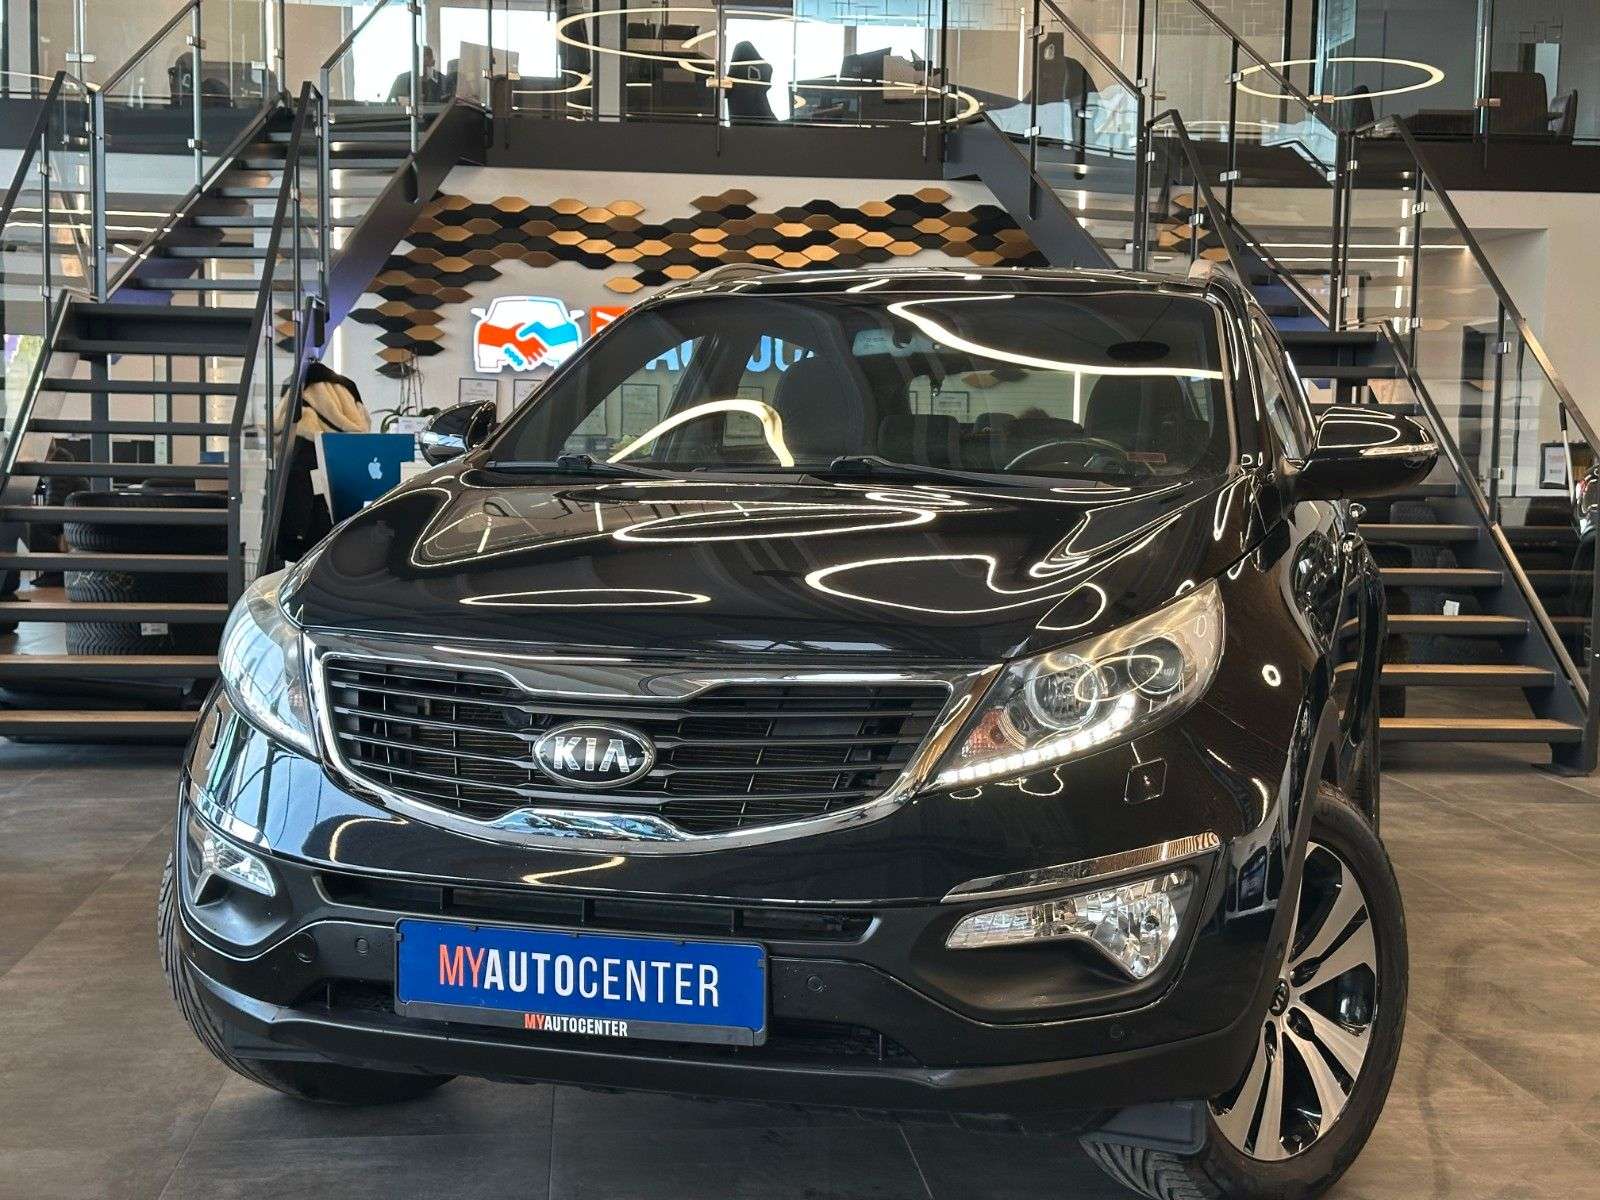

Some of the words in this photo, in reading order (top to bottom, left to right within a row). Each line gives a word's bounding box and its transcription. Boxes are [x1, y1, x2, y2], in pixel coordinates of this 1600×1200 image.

[553, 736, 630, 773] KIA
[439, 944, 719, 1007] MYAUTOCENTER
[524, 1013, 628, 1037] MYAUTOCENTER
